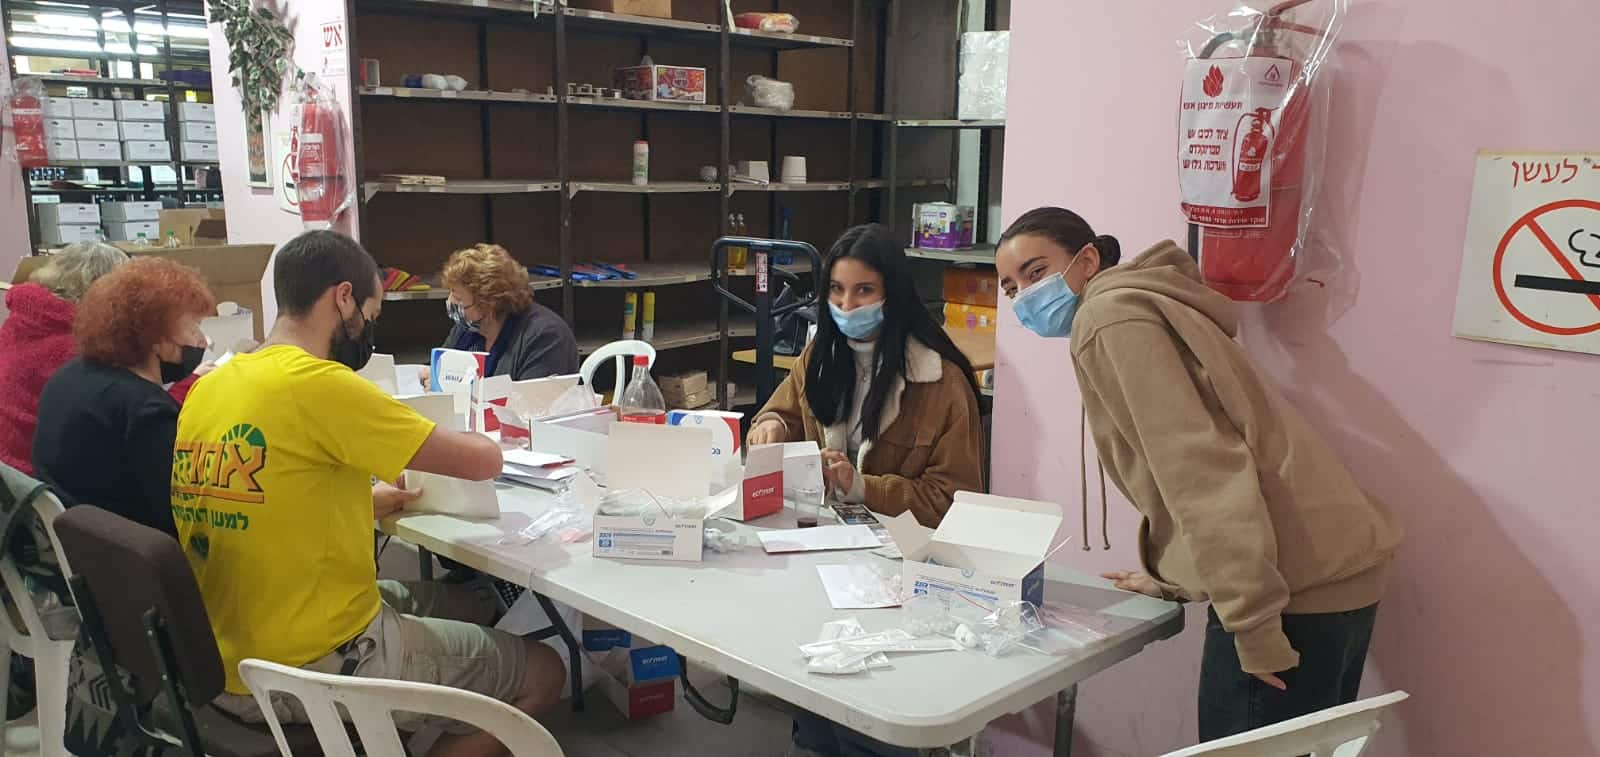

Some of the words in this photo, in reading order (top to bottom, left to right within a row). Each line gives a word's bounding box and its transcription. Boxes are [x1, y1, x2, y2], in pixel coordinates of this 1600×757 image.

[323, 25, 343, 47] אש
[1511, 158, 1578, 188] לעשן
[211, 508, 249, 531] למען
